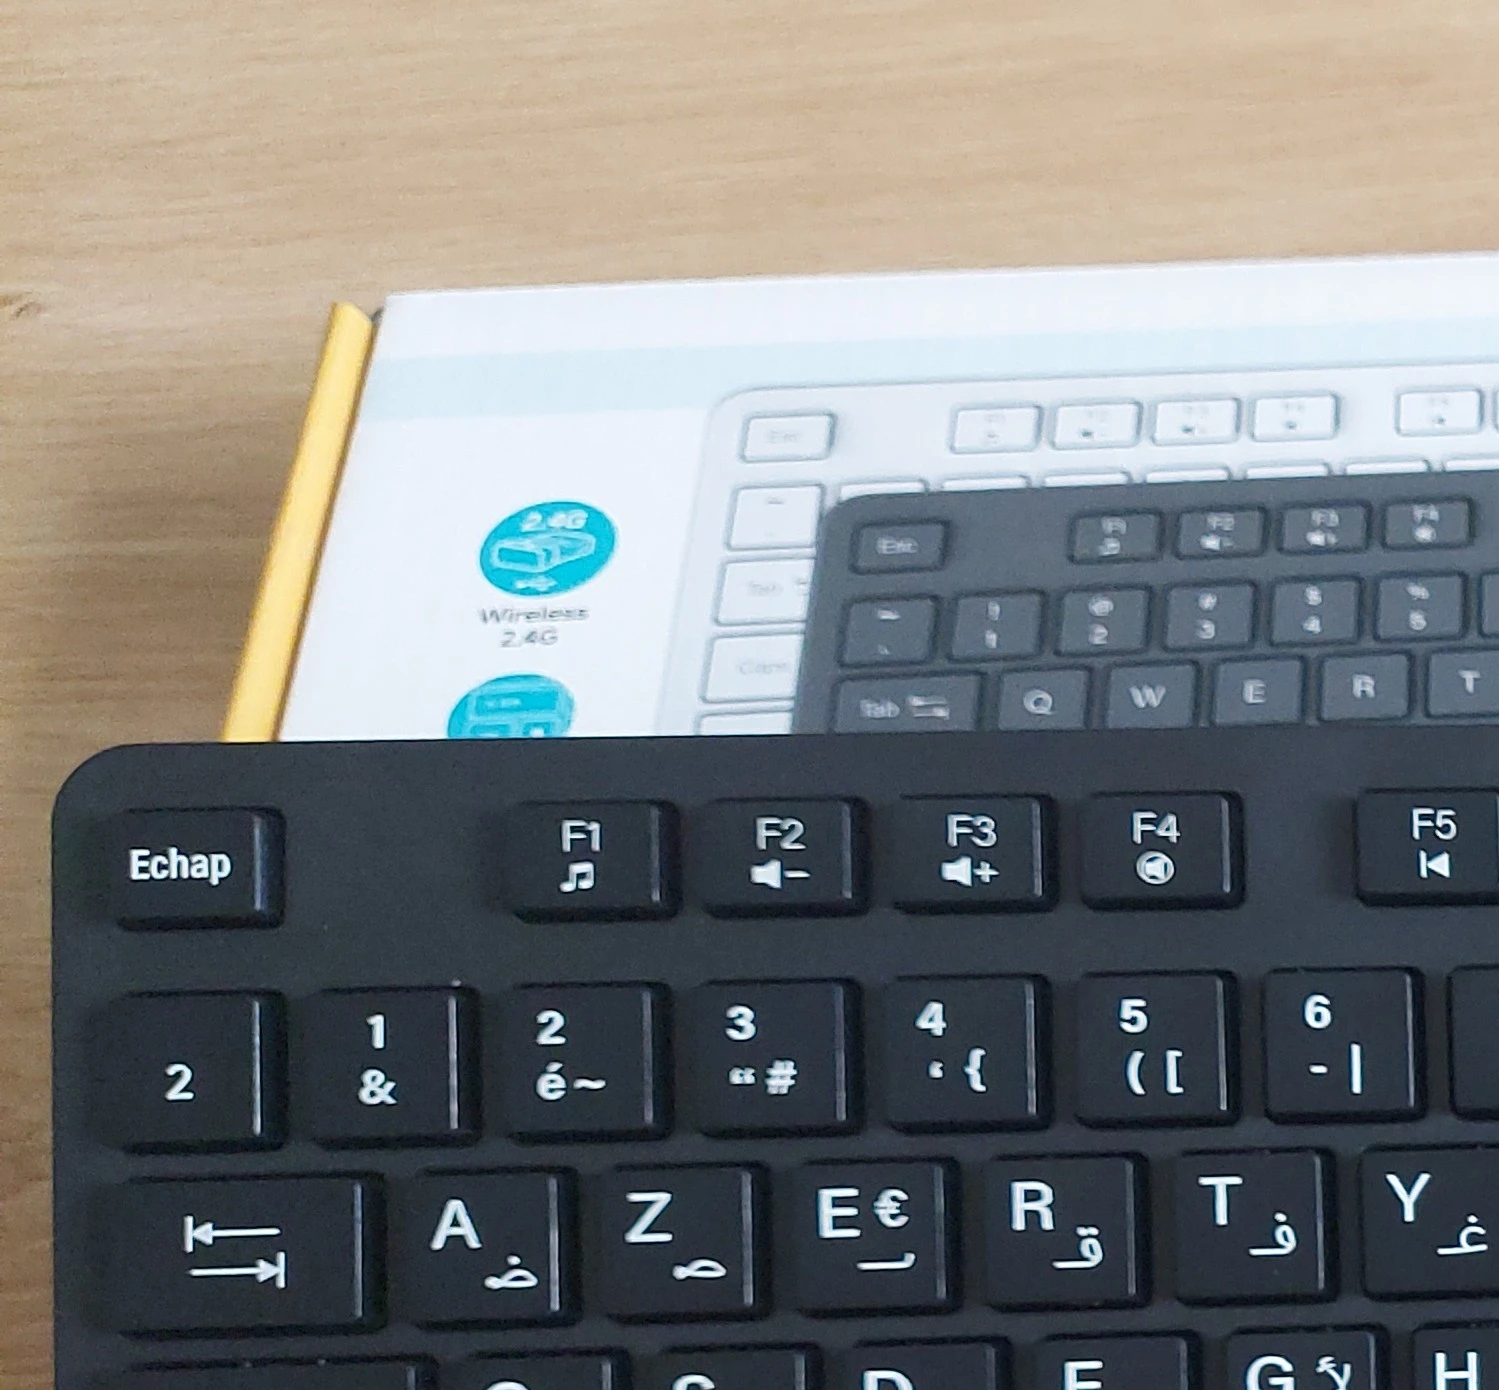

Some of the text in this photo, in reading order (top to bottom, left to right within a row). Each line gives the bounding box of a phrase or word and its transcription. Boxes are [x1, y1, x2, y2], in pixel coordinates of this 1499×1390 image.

[477, 606, 590, 625] Wireless
[500, 629, 559, 649] 2.4G
[1129, 685, 1166, 709] W
[1242, 679, 1267, 704] E
[1351, 674, 1375, 699] R
[1459, 670, 1482, 693] T
[1022, 689, 1055, 716] Q
[562, 820, 601, 852] F1
[756, 817, 806, 850] F2
[947, 814, 997, 847] F3
[1133, 811, 1181, 844] F4
[1412, 808, 1457, 840] F5
[129, 847, 231, 886] Echap
[536, 1010, 566, 1045] 2
[726, 1005, 756, 1041] 3
[916, 1001, 947, 1036] 4
[1120, 998, 1148, 1033] 5
[1304, 994, 1332, 1029] 6
[366, 1014, 385, 1049] 1
[165, 1063, 194, 1101] 2
[358, 1069, 397, 1105] &
[1011, 1181, 1054, 1231] R
[1198, 1176, 1243, 1226] T
[1386, 1173, 1431, 1222] Y
[431, 1199, 482, 1251] A
[625, 1191, 673, 1243] Z
